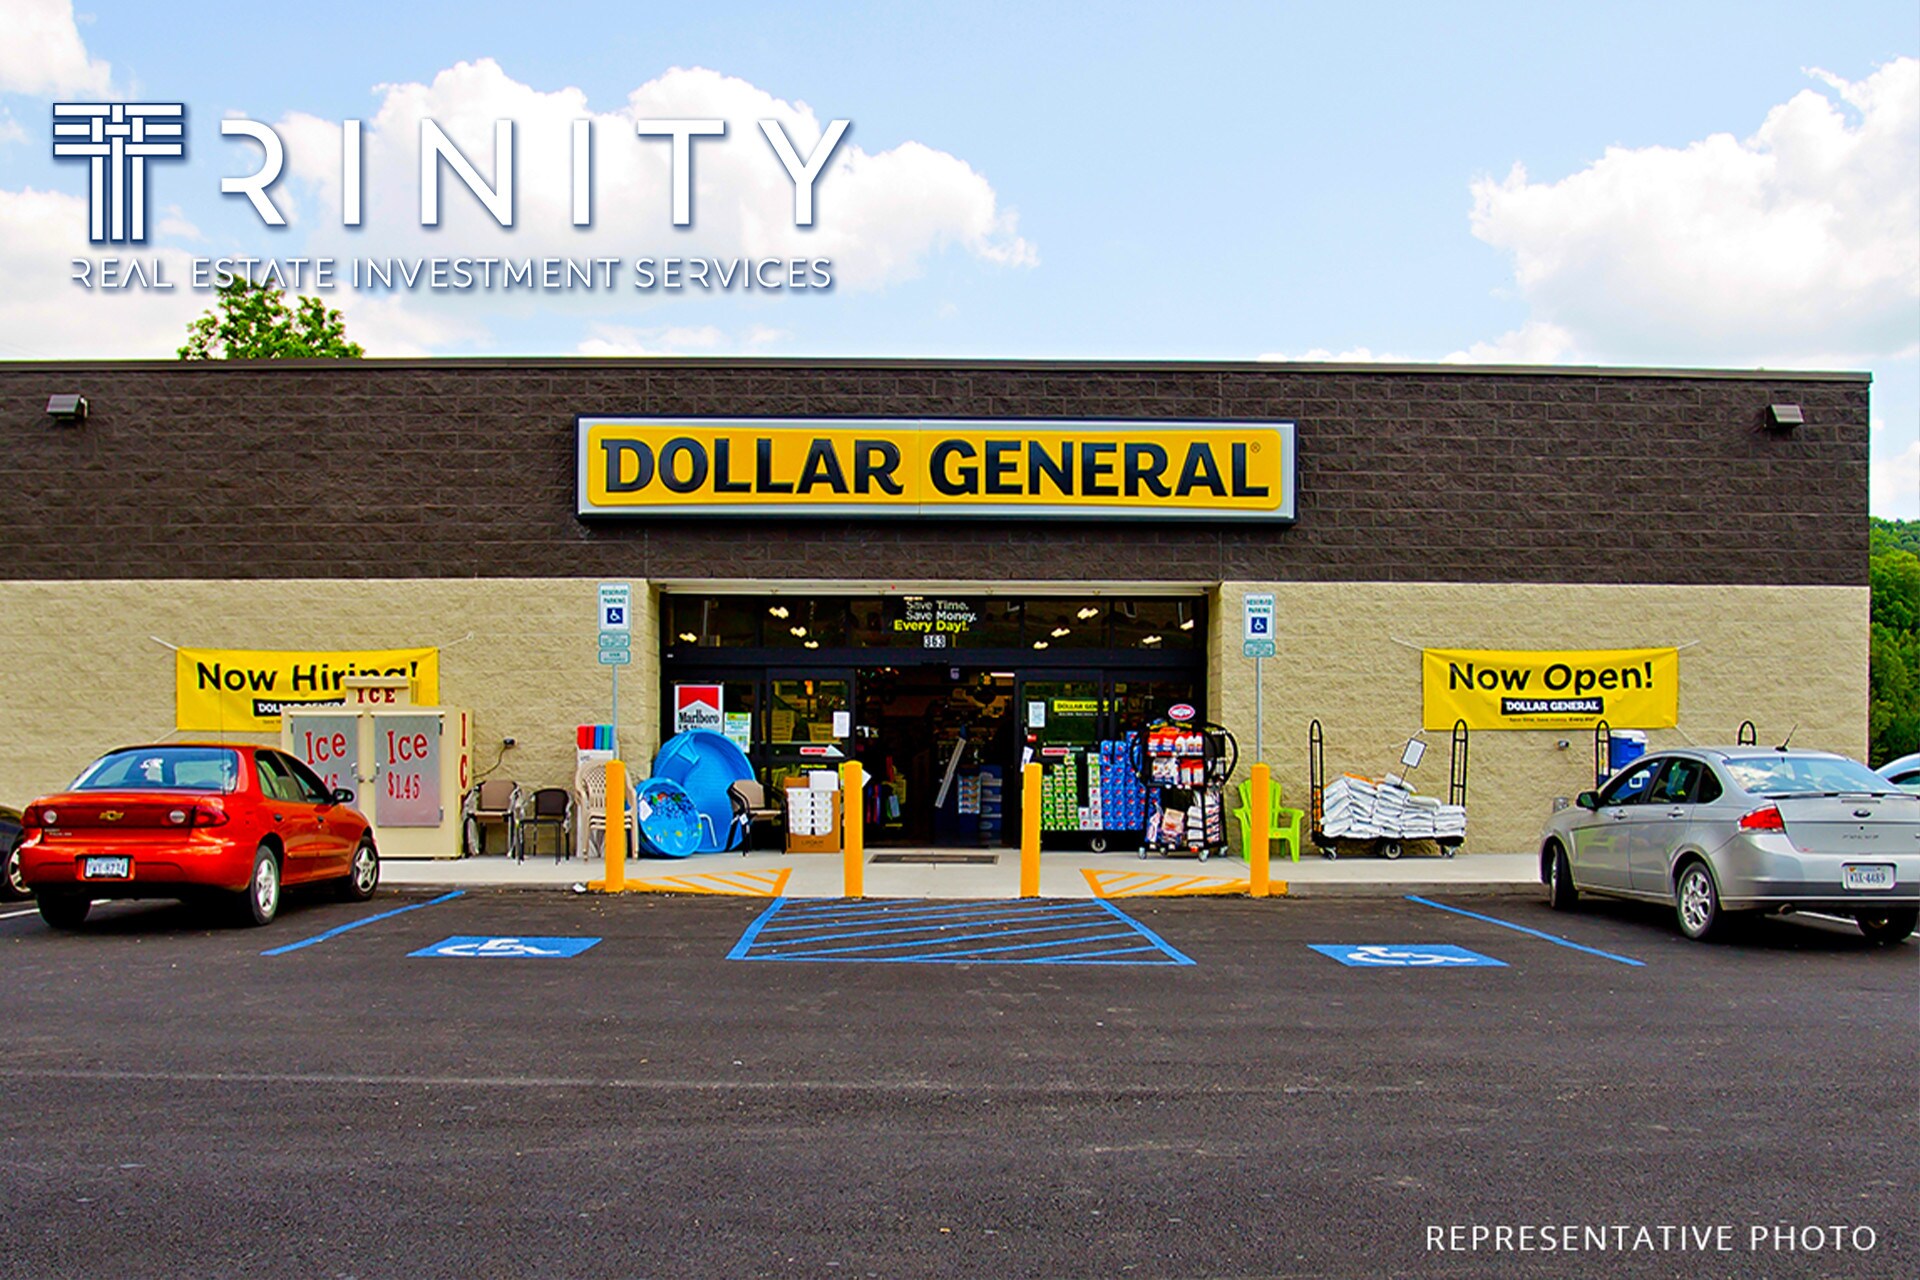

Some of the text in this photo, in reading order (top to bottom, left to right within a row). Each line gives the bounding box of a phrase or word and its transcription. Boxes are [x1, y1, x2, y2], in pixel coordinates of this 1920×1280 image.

[601, 437, 1269, 498] DOLLAR GENERAL
[906, 600, 969, 610] Save Time.
[894, 620, 933, 633] Every
[906, 610, 977, 622] Save Money.
[197, 662, 278, 691] Now
[1449, 661, 1653, 695] Now Open!
[357, 688, 396, 703] ICE
[1506, 700, 1599, 711] DOLLAR GENERAL
[678, 709, 720, 724] Marlboro
[305, 731, 346, 765] Ice
[387, 730, 428, 765] Ice
[388, 771, 420, 799] $1.45
